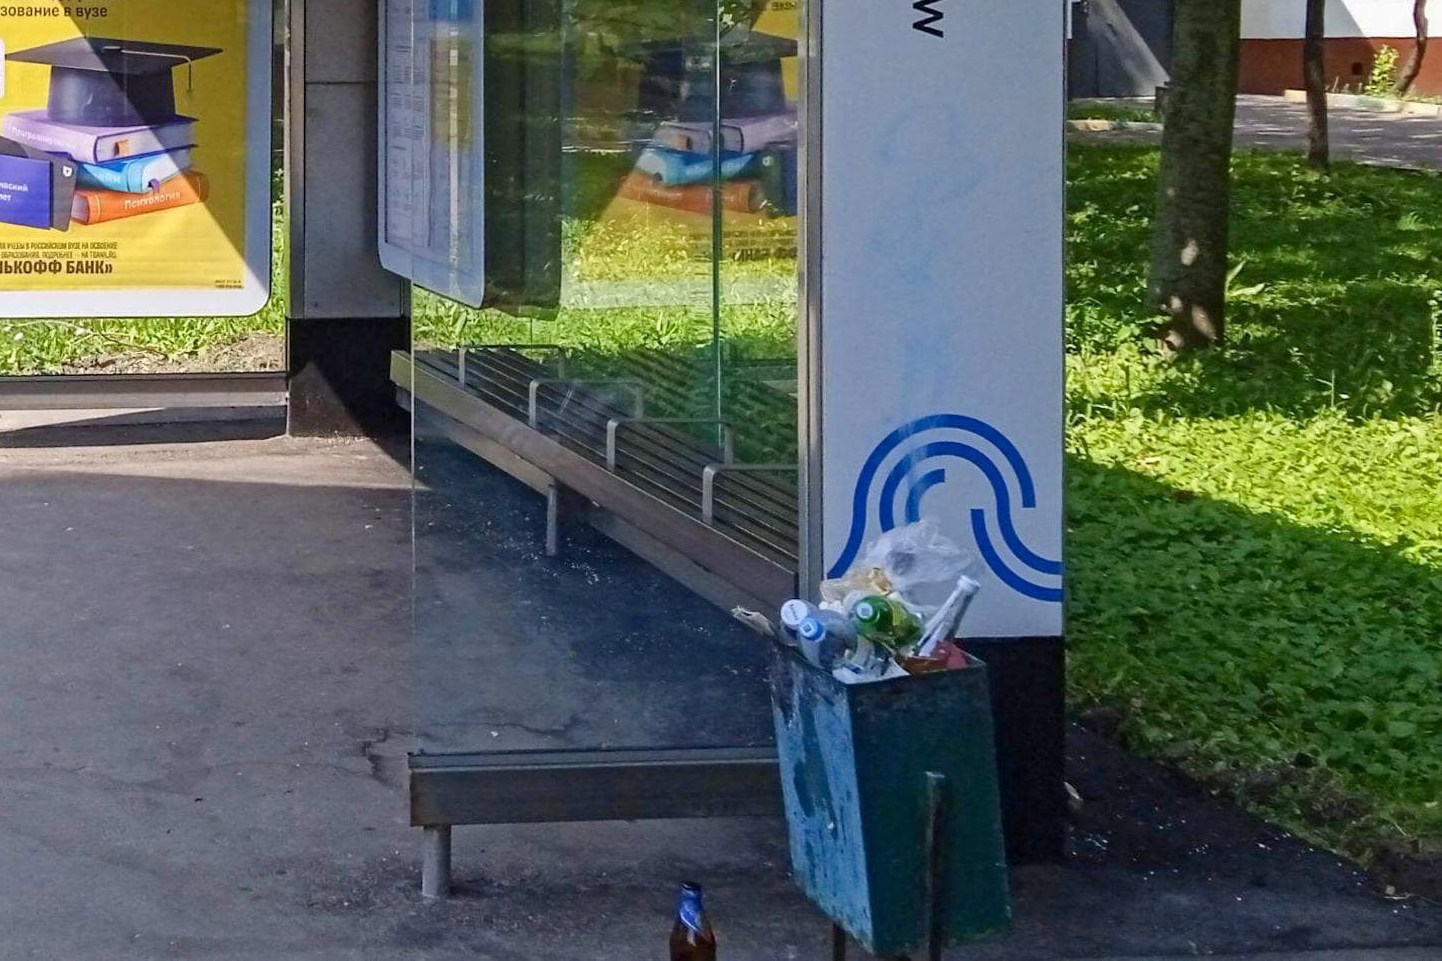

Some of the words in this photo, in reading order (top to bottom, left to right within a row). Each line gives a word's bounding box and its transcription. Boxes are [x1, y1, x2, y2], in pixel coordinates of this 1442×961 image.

[63, 6, 72, 16] в
[75, 6, 108, 18] вузе
[66, 260, 113, 275] БАНК»
